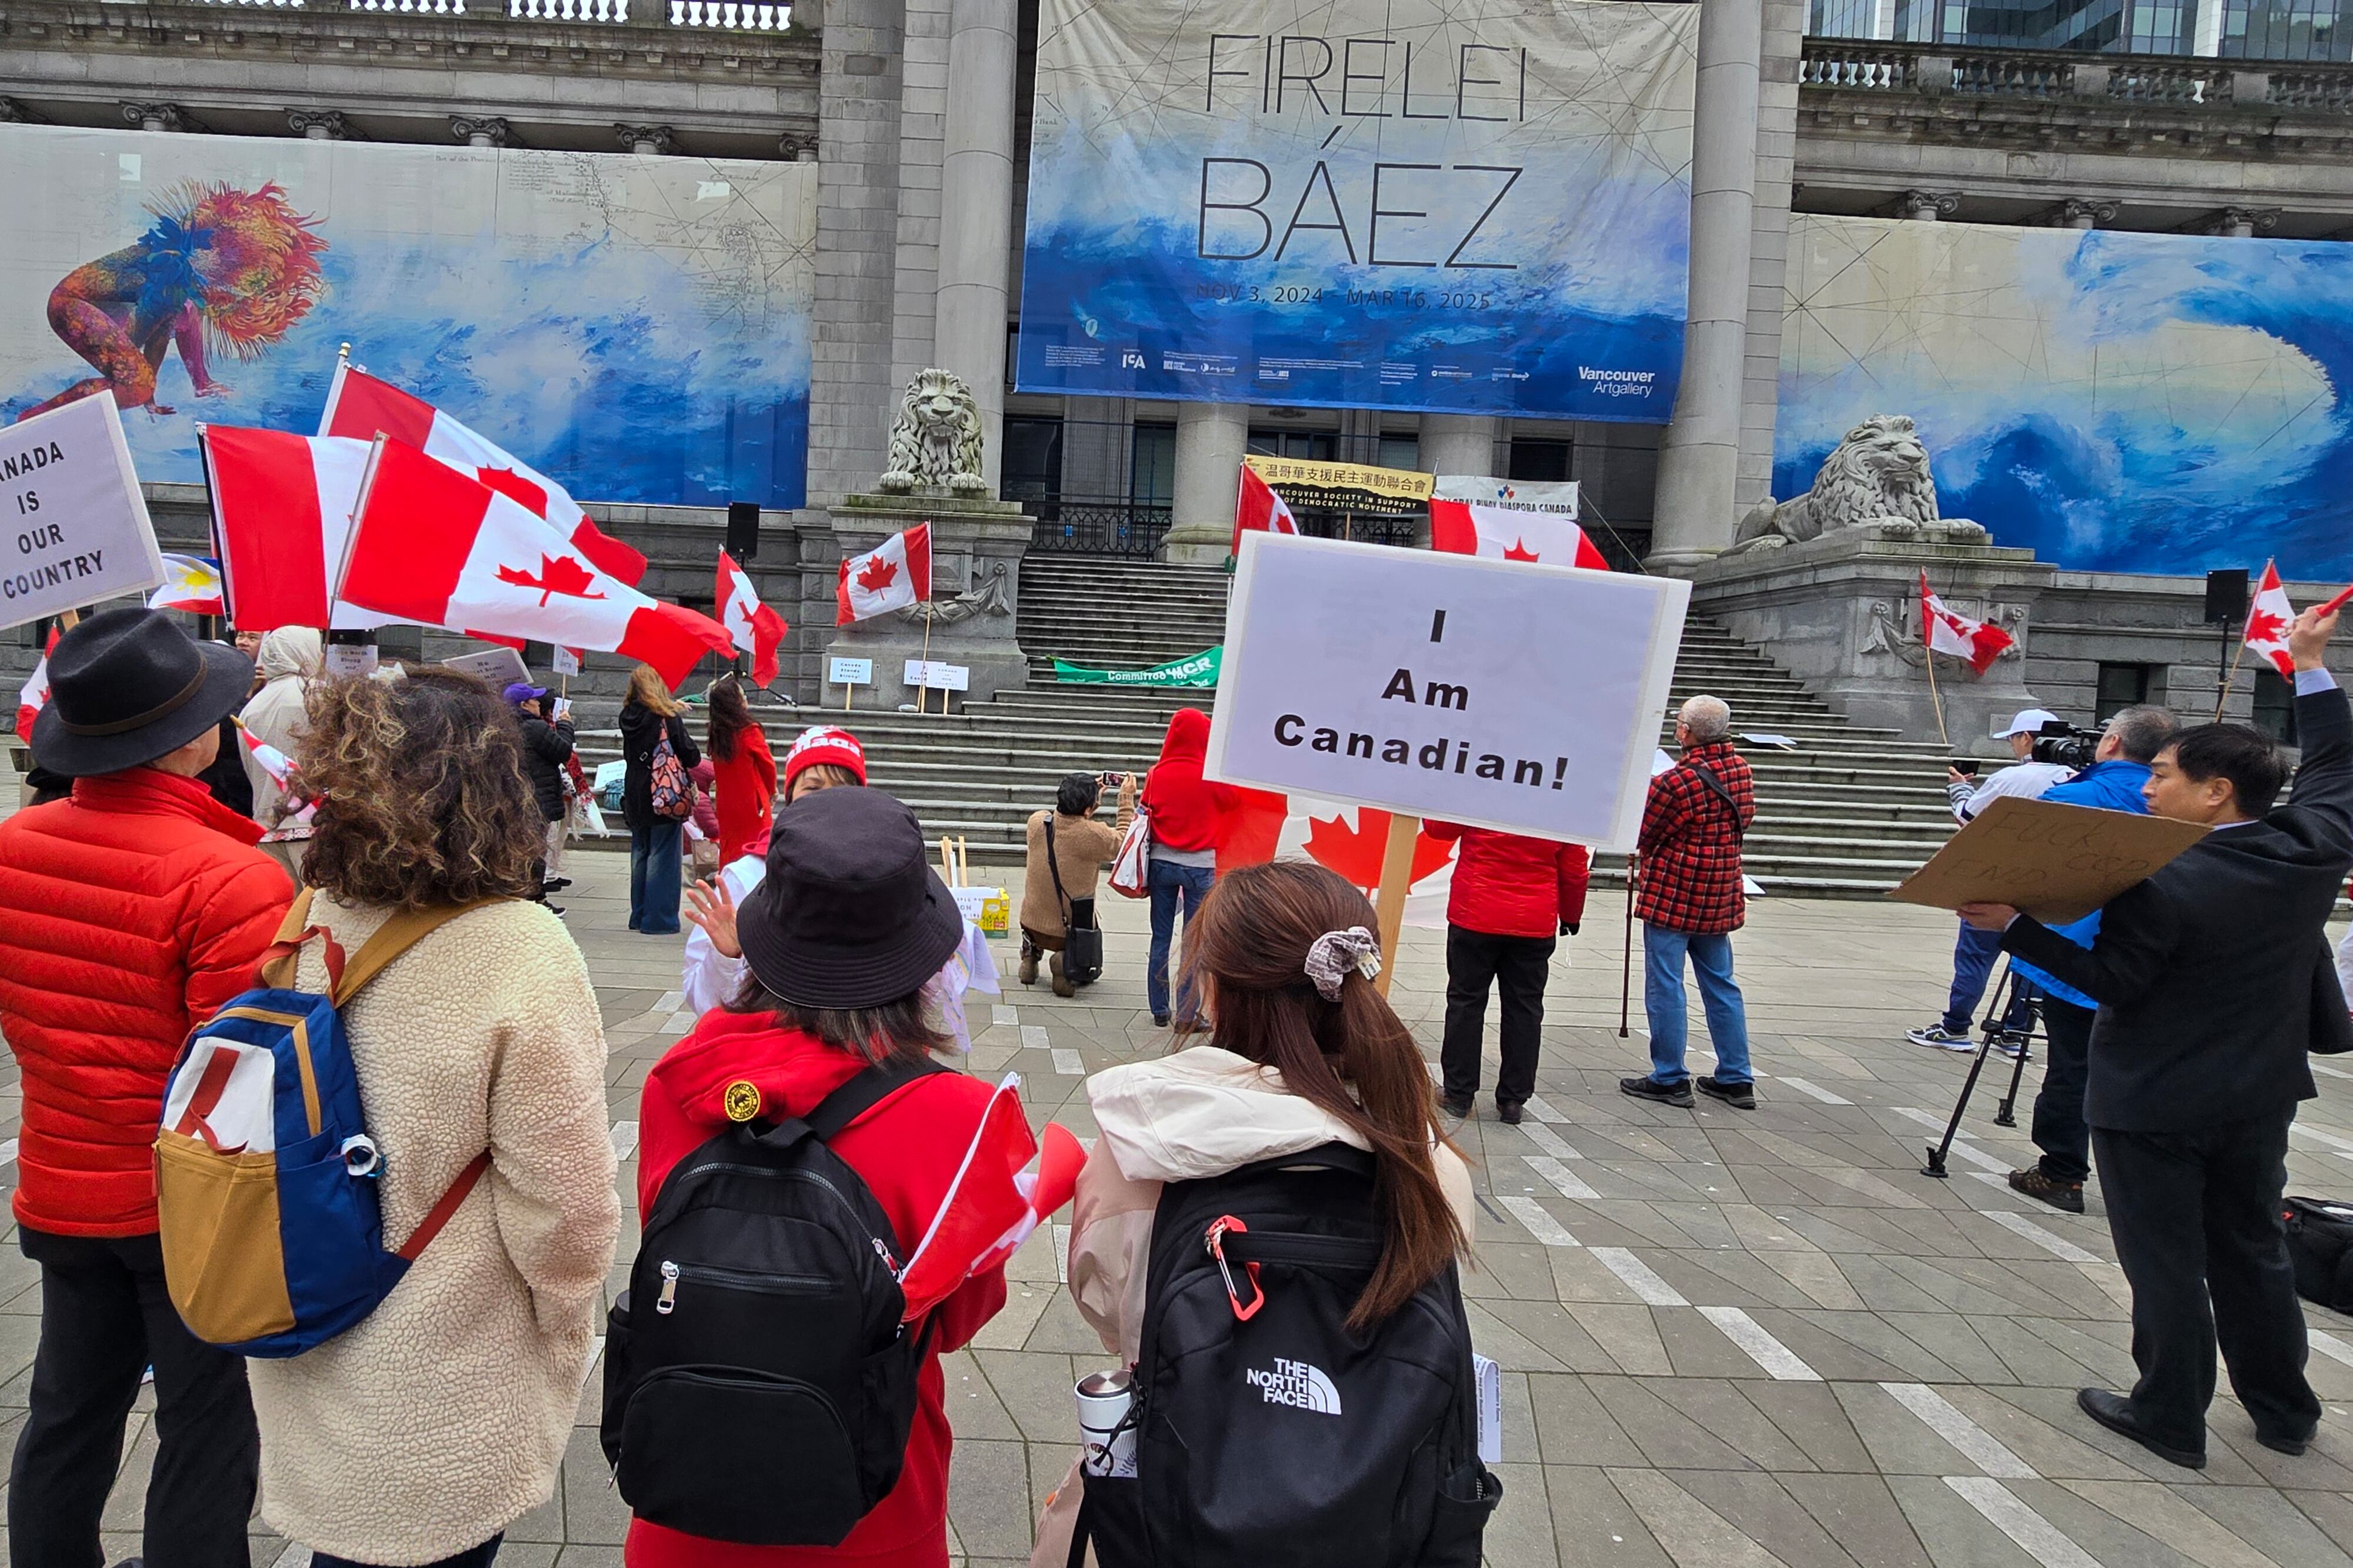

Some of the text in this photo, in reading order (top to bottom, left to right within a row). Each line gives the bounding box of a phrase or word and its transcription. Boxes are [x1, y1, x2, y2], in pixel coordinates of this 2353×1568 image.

[1206, 34, 1526, 122] FIRELEI
[1197, 125, 1523, 269] BÁEZ
[1195, 283, 1241, 300] NOV
[1249, 286, 1266, 304] 3,
[1274, 286, 1324, 303] 2024
[1346, 289, 1394, 306] MAR
[1404, 291, 1431, 310] 16,
[1439, 292, 1491, 310] 2025
[1578, 366, 1655, 382] Vancouver
[1592, 381, 1653, 398] Artgallery
[0, 441, 65, 482] NADA
[16, 491, 40, 515] IS
[1274, 488, 1320, 498] ANCOUVER
[1324, 492, 1362, 501] SOCIETY
[1377, 498, 1417, 509] SUPPORT
[1298, 498, 1355, 509] DEMOCRATIC
[1358, 503, 1404, 515] MOVEMENT
[1499, 501, 1537, 512] DIASPORA
[1539, 503, 1572, 513] CANADA
[18, 523, 65, 554] OUR
[3, 549, 103, 599] COUNTRY
[1429, 609, 1447, 643] I
[1381, 668, 1469, 711] Am
[1273, 713, 1569, 791] Canadian!
[1247, 1368, 1308, 1393] NORTH
[1274, 1357, 1308, 1379] THE
[1264, 1387, 1308, 1409] FACE
